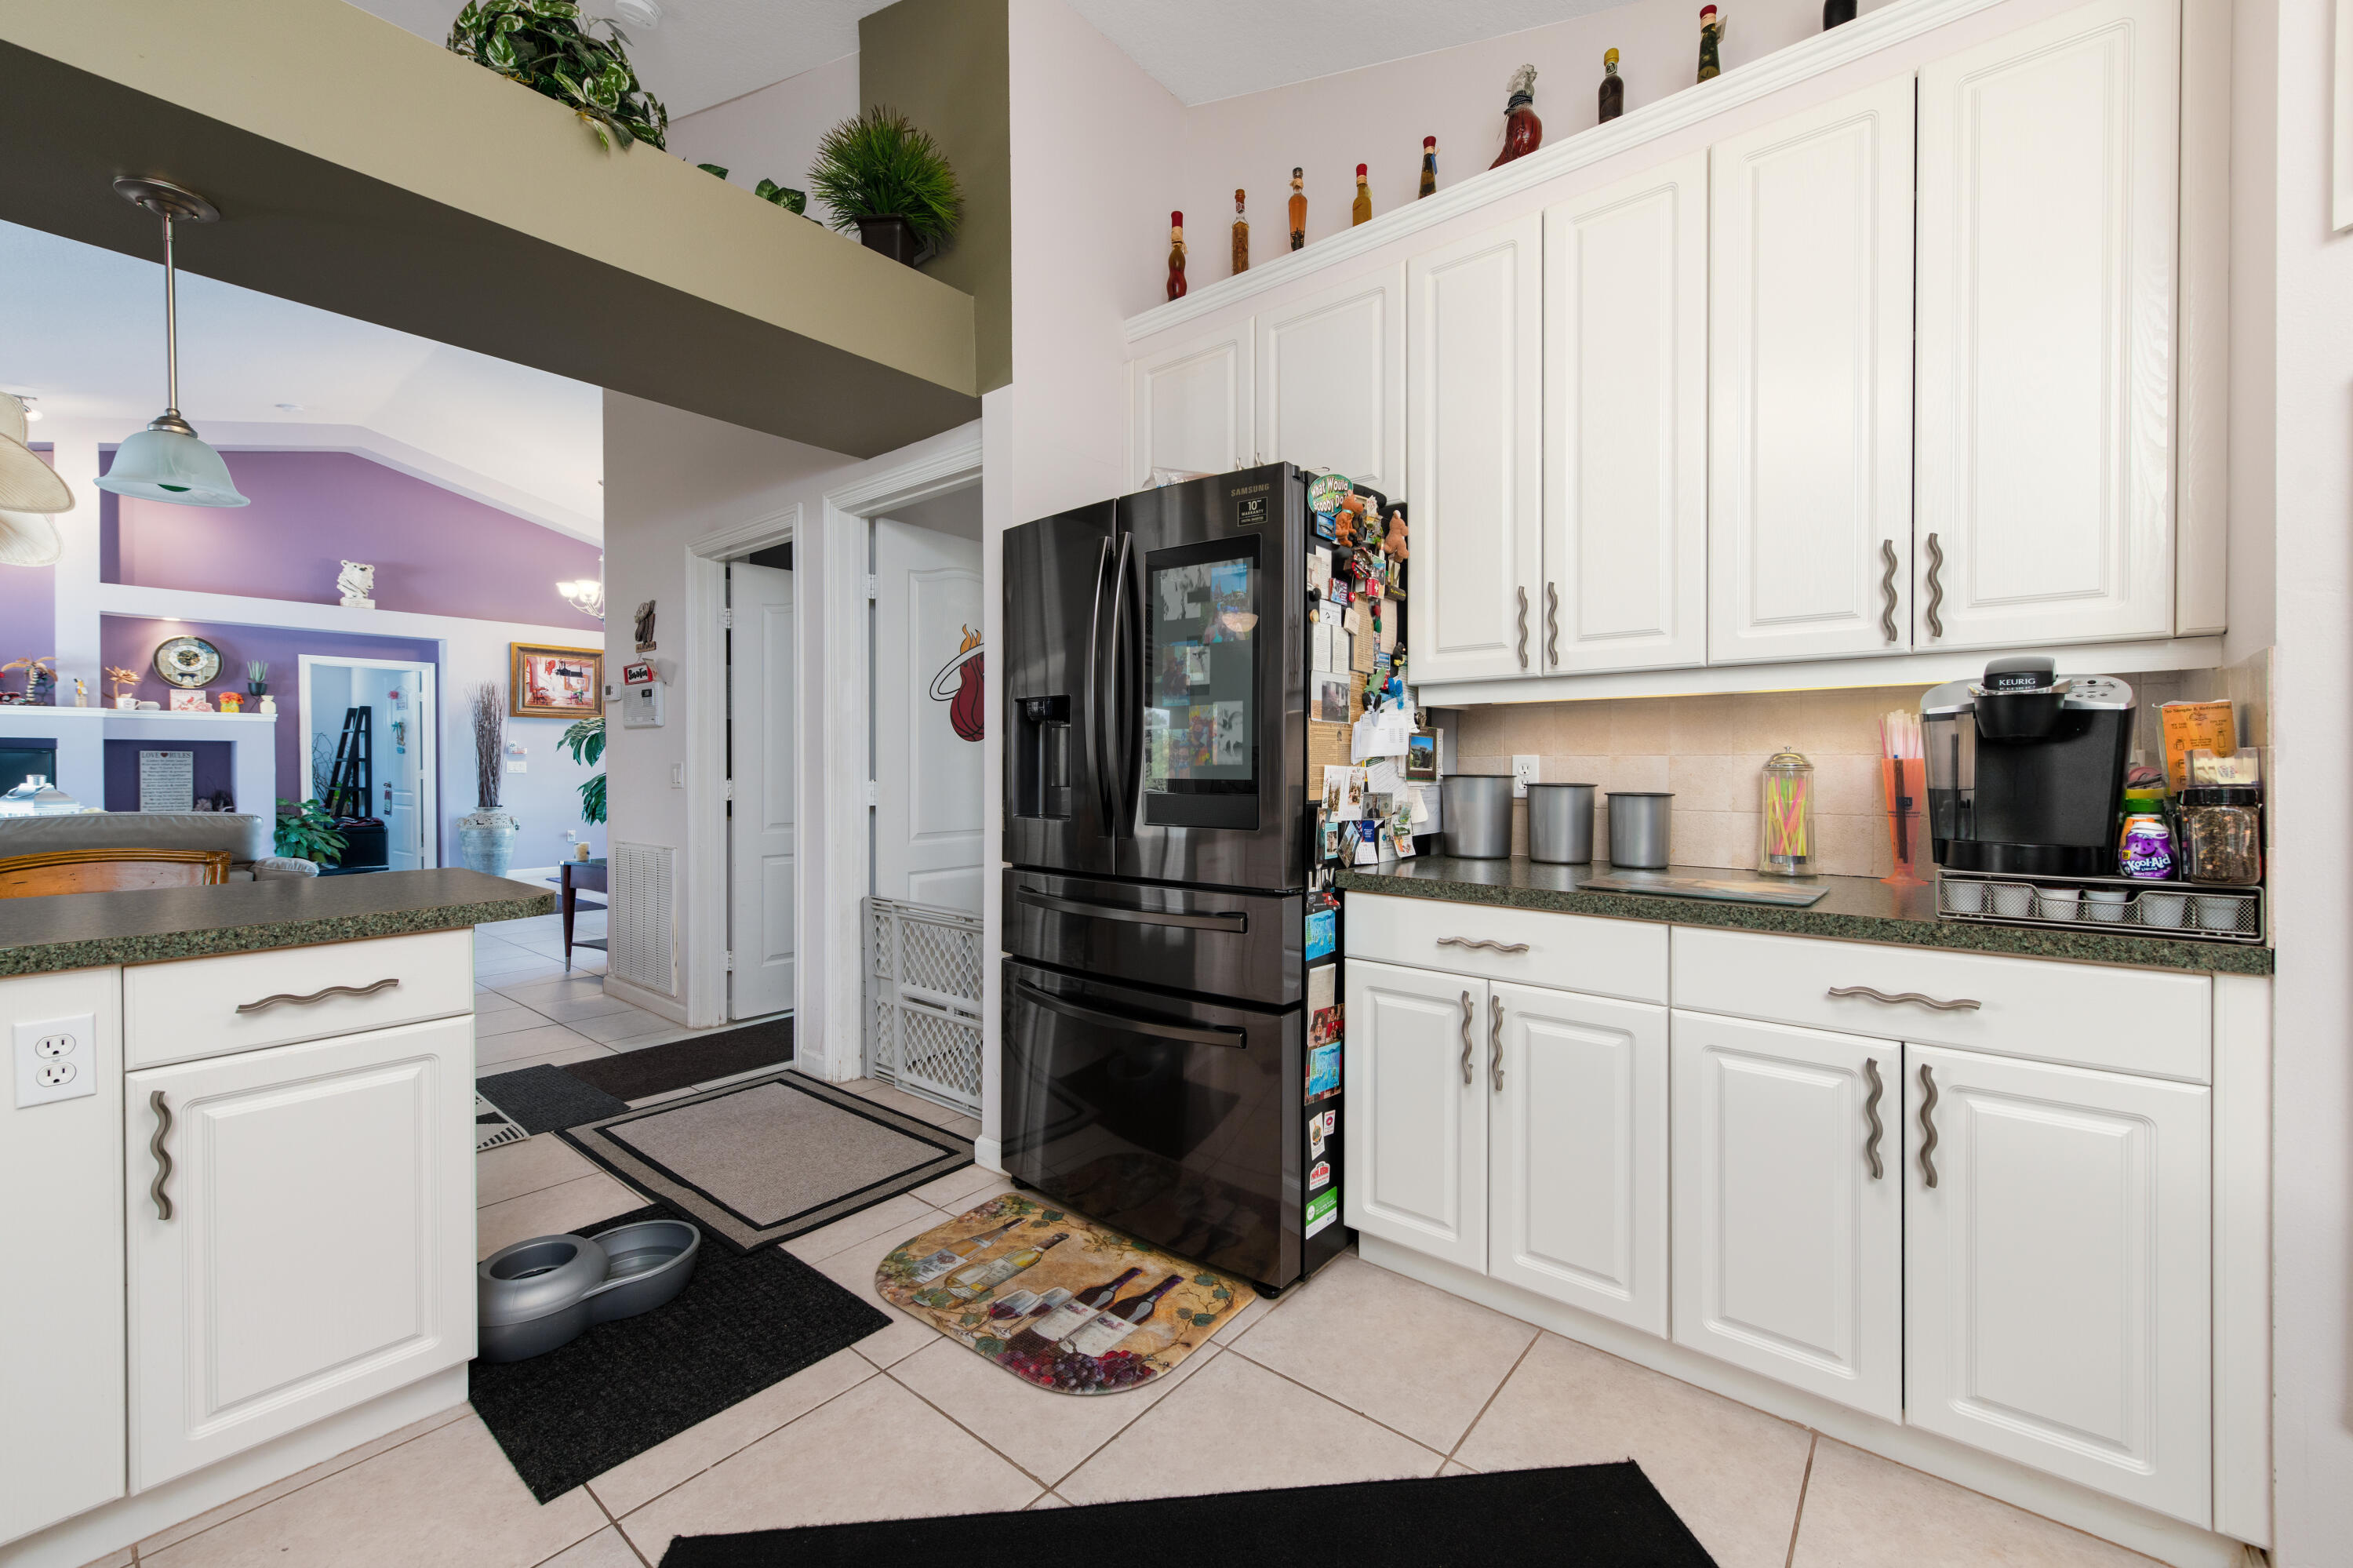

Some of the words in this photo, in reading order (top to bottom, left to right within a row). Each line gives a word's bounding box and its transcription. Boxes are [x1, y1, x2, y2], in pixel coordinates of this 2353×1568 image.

[1231, 483, 1270, 497] SAMSUNG
[1311, 478, 1326, 499] What
[1326, 475, 1348, 493] Would
[1248, 500, 1257, 511] 10
[2127, 853, 2171, 871] Kool-Aid
